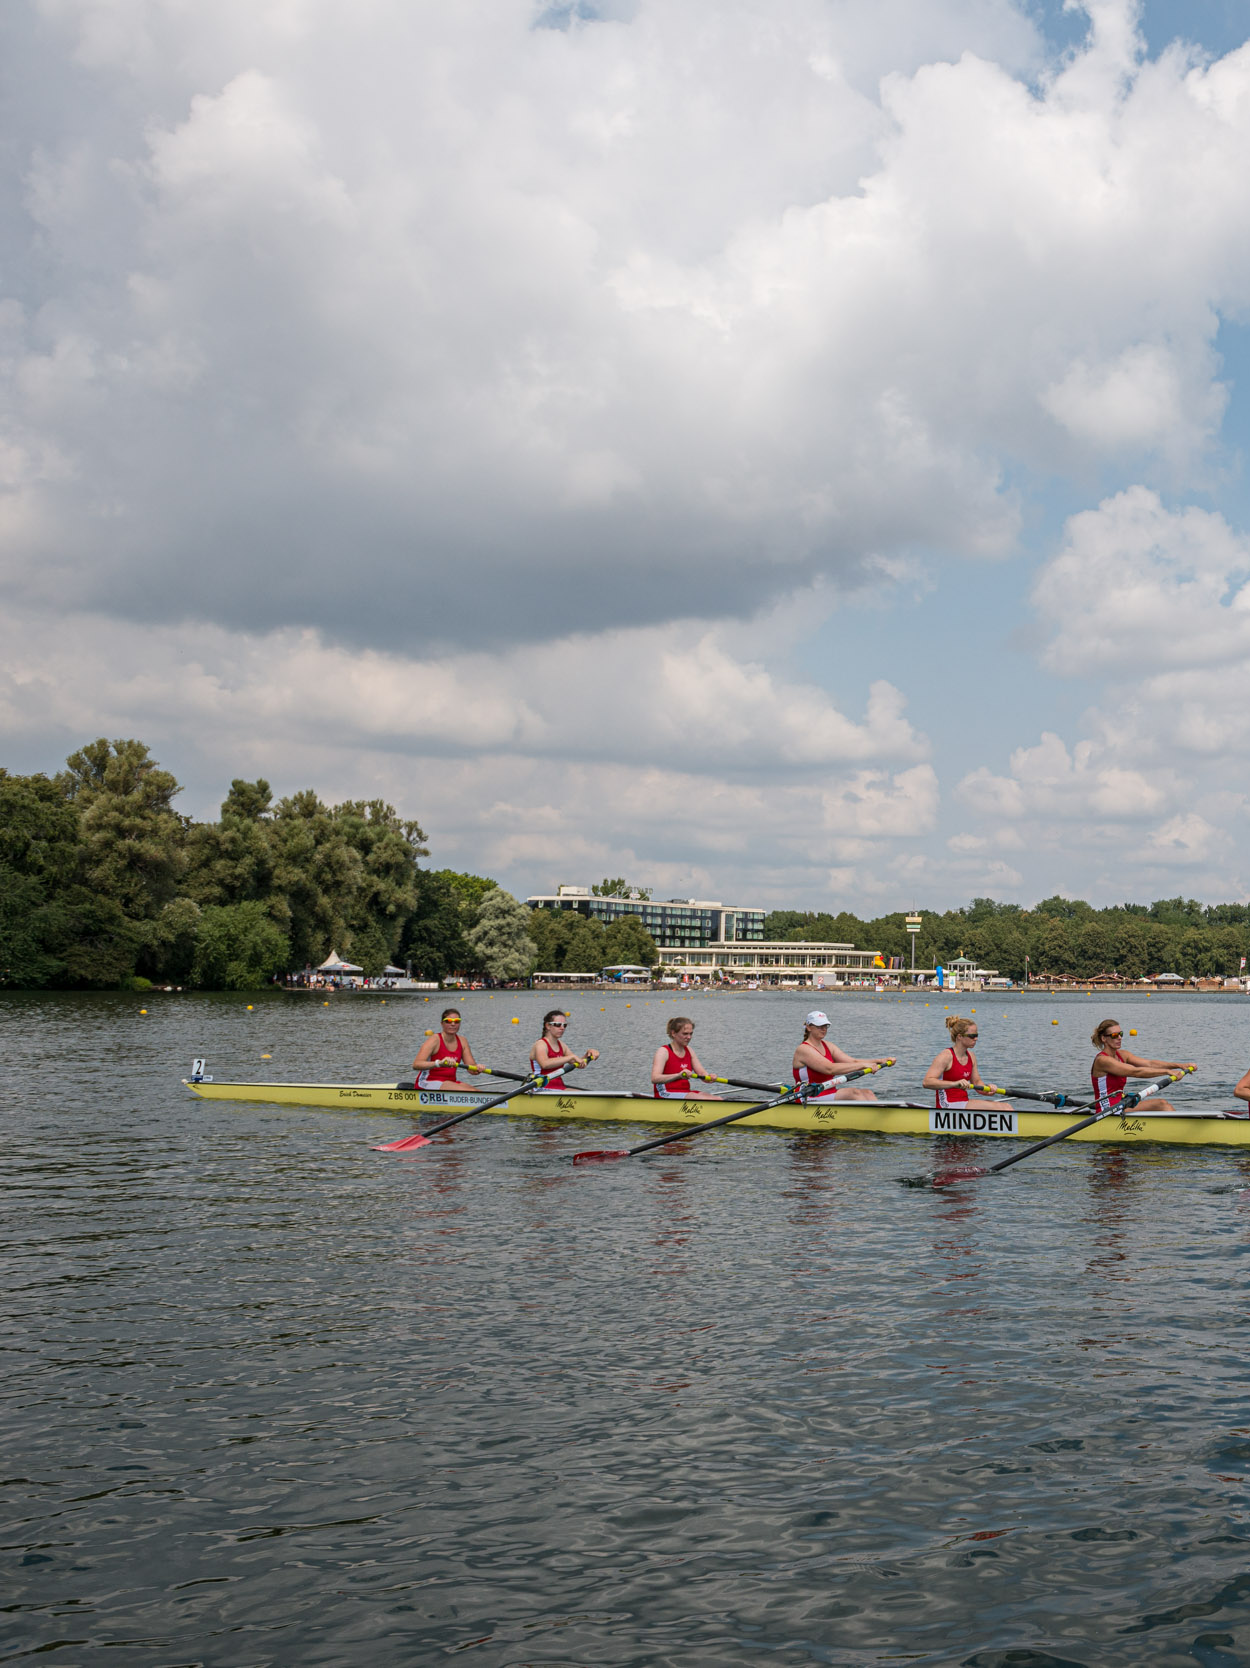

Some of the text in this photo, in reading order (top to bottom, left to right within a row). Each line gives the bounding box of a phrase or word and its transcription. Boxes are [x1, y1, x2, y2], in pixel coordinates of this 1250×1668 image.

[195, 1060, 202, 1074] 2
[388, 1092, 392, 1100] Z
[395, 1092, 403, 1100] BS
[429, 1093, 447, 1102] RBL
[811, 1106, 835, 1119] Melitta
[934, 1112, 1012, 1131] MINDEN
[1116, 1119, 1143, 1131] Melitta
